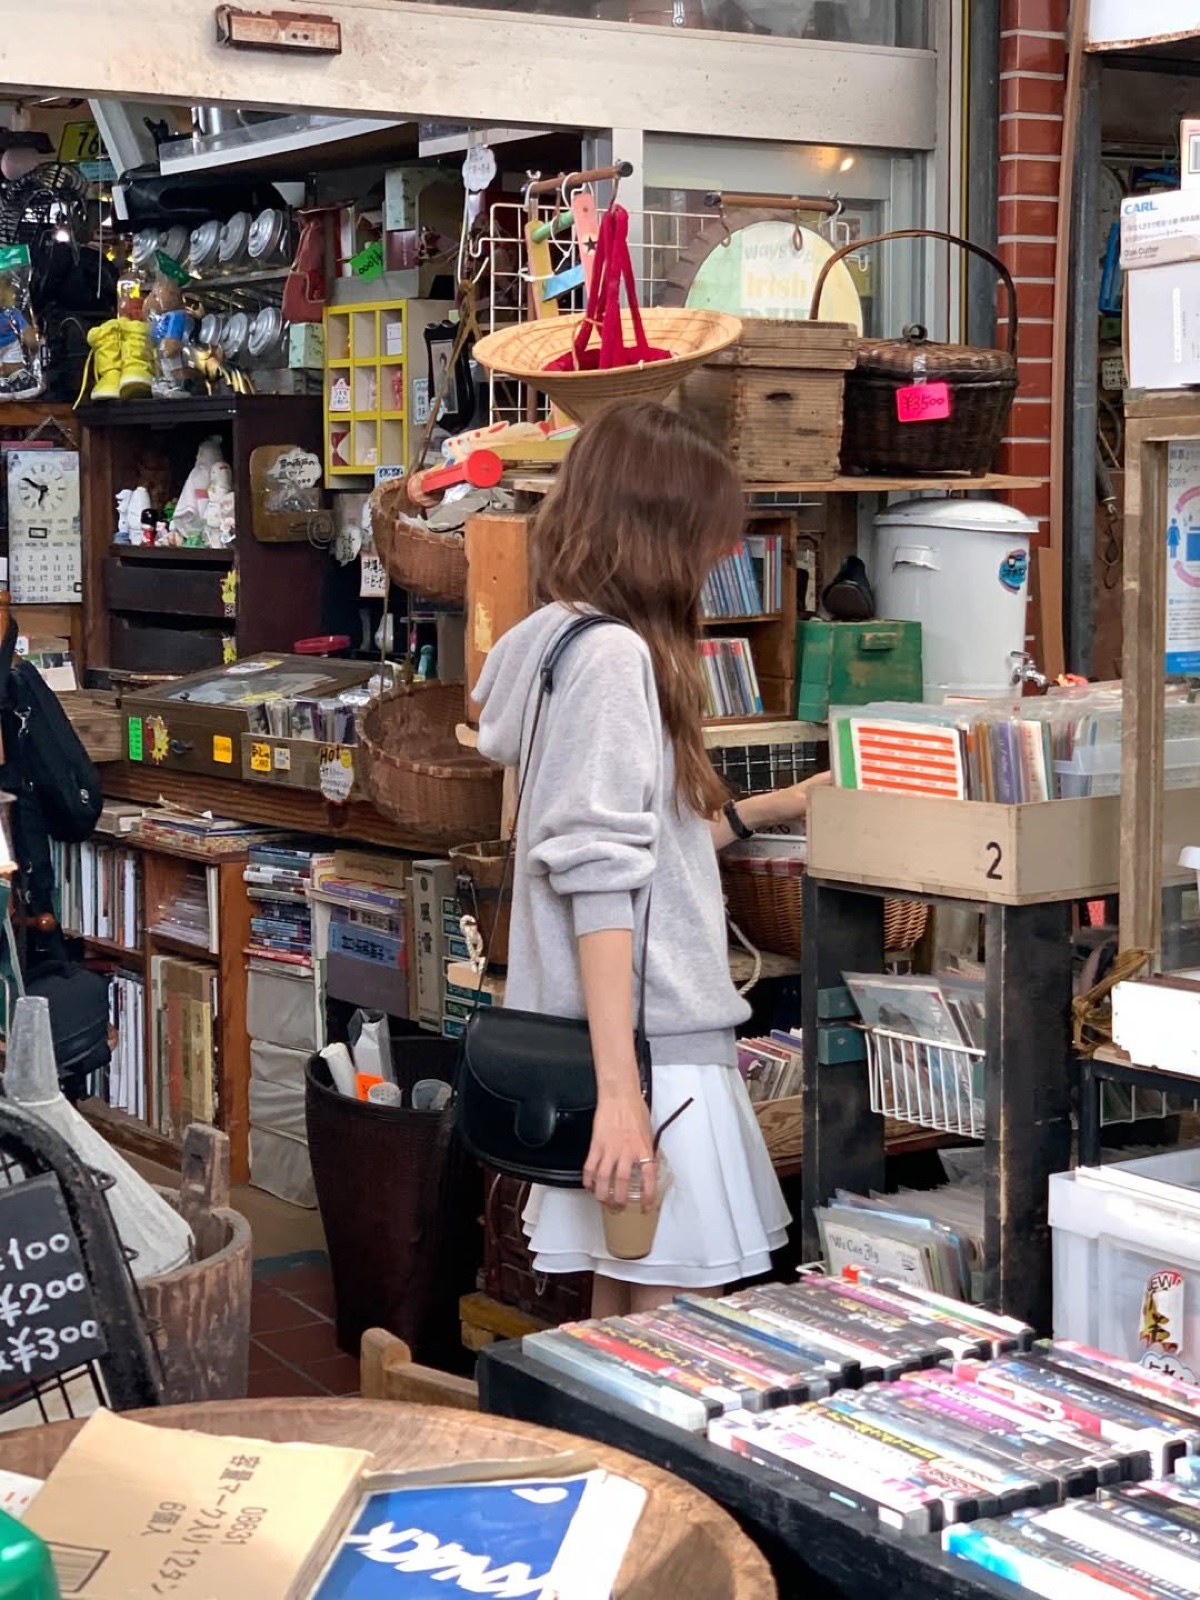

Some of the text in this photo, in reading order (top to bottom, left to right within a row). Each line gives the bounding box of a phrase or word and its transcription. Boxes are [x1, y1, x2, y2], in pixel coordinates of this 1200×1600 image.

[1124, 201, 1158, 215] CARL
[746, 271, 808, 298] Irish
[986, 841, 1003, 881] 2
